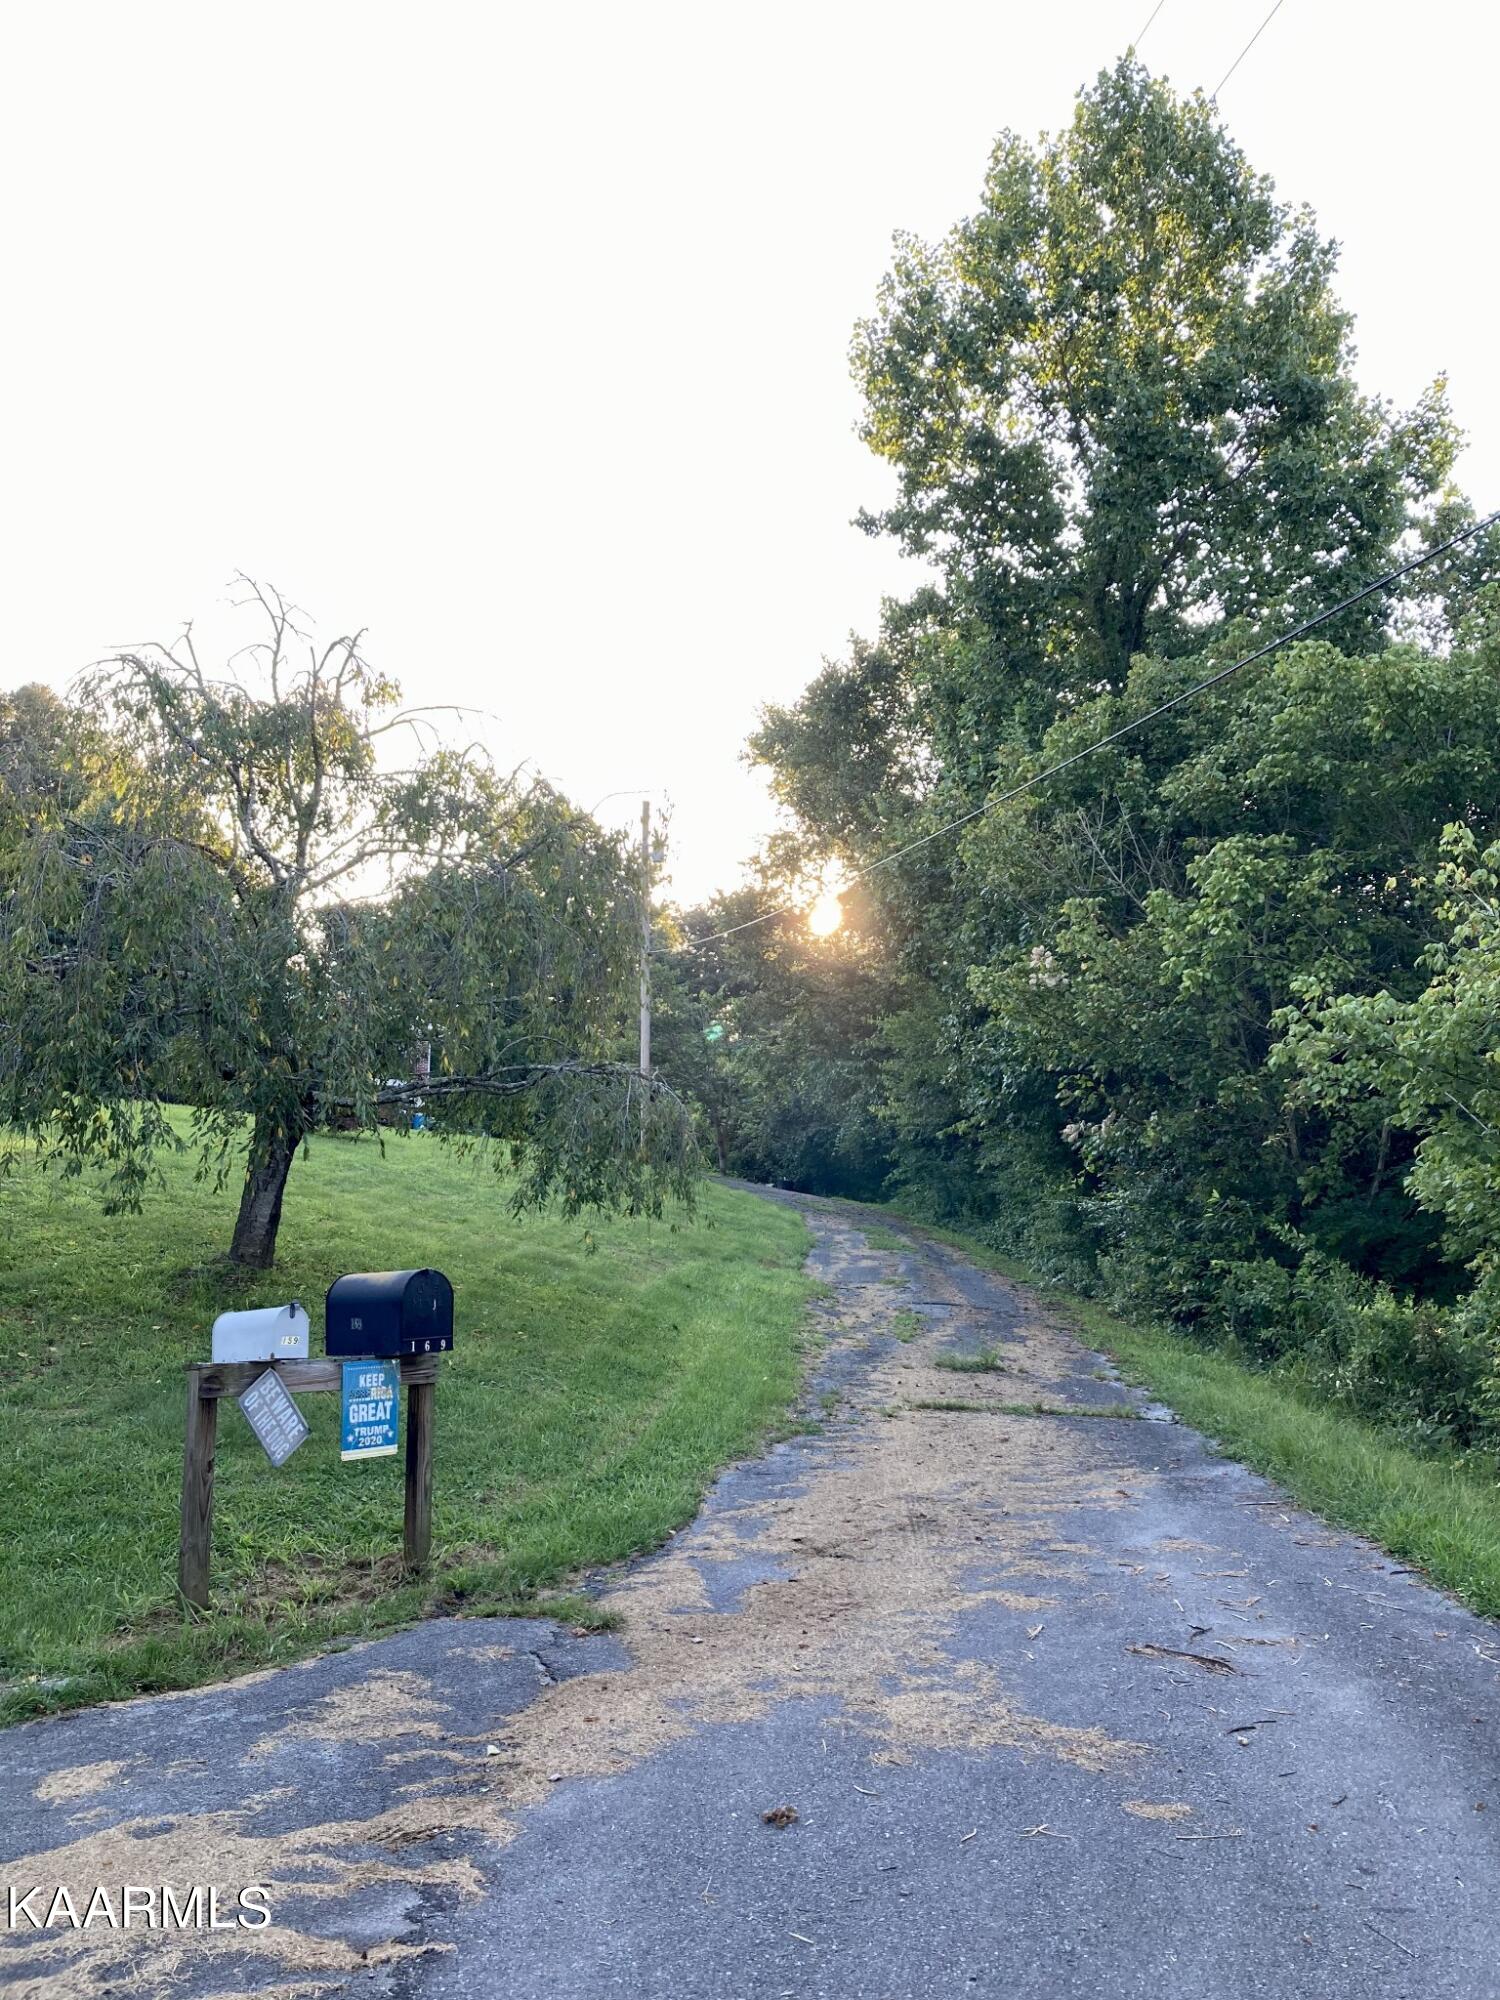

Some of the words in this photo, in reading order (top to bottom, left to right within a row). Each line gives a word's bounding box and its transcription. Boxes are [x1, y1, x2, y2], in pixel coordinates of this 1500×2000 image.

[411, 1339, 446, 1353] 169
[359, 1373, 385, 1388] KEEP
[244, 1391, 263, 1411] OF
[254, 1405, 277, 1436] THE
[260, 1377, 304, 1442] BEWARE
[349, 1401, 393, 1424] GREAT
[354, 1424, 389, 1437] TRUMP
[358, 1435, 383, 1447] 2020
